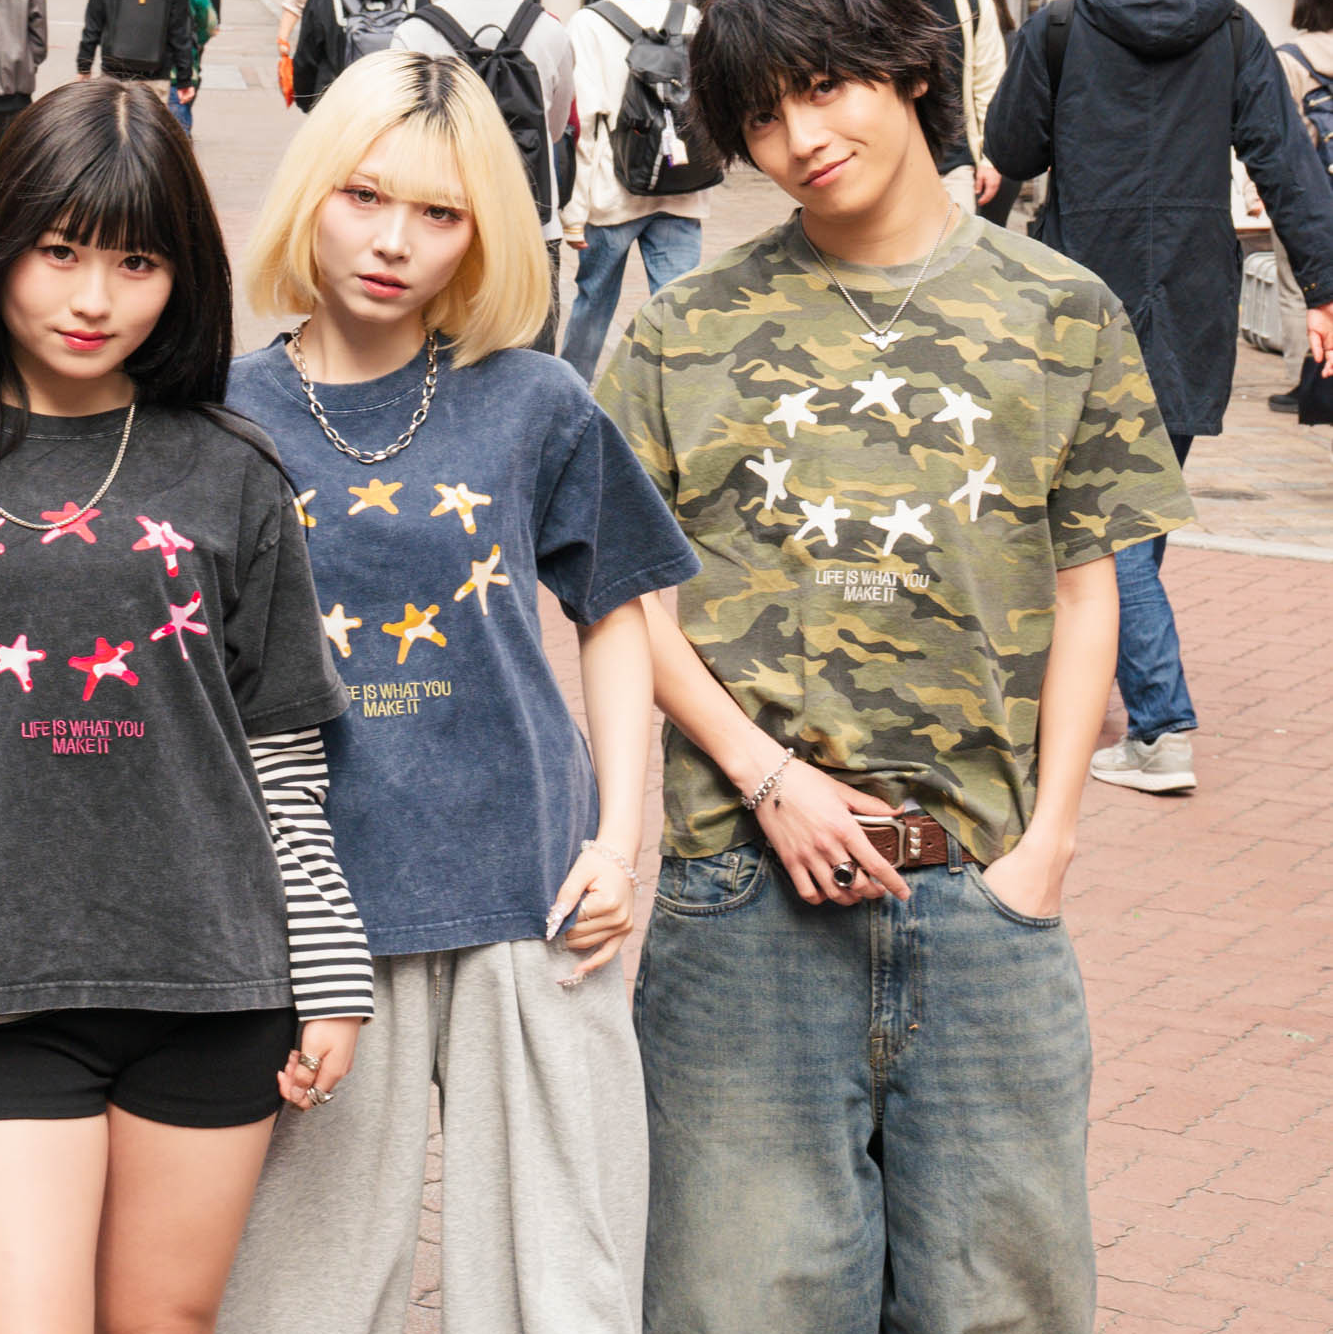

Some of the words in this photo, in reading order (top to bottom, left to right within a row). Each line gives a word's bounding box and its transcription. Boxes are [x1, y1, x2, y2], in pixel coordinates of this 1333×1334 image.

[816, 570, 844, 585] LIFE
[846, 570, 858, 585] IS
[861, 571, 899, 587] WHAT
[902, 573, 930, 588] YOU
[843, 586, 882, 602] MAKE
[883, 587, 898, 602] IT
[363, 684, 377, 699] IS
[379, 682, 420, 699] WHAT
[423, 680, 451, 697] YOU
[363, 700, 404, 717] MAKE
[407, 699, 421, 714] IT
[21, 720, 51, 738] LIFE
[52, 720, 66, 736] IS
[69, 720, 112, 737] WHAT
[115, 720, 145, 738] YOU
[52, 737, 95, 754] MAKE
[98, 738, 112, 754] IT
